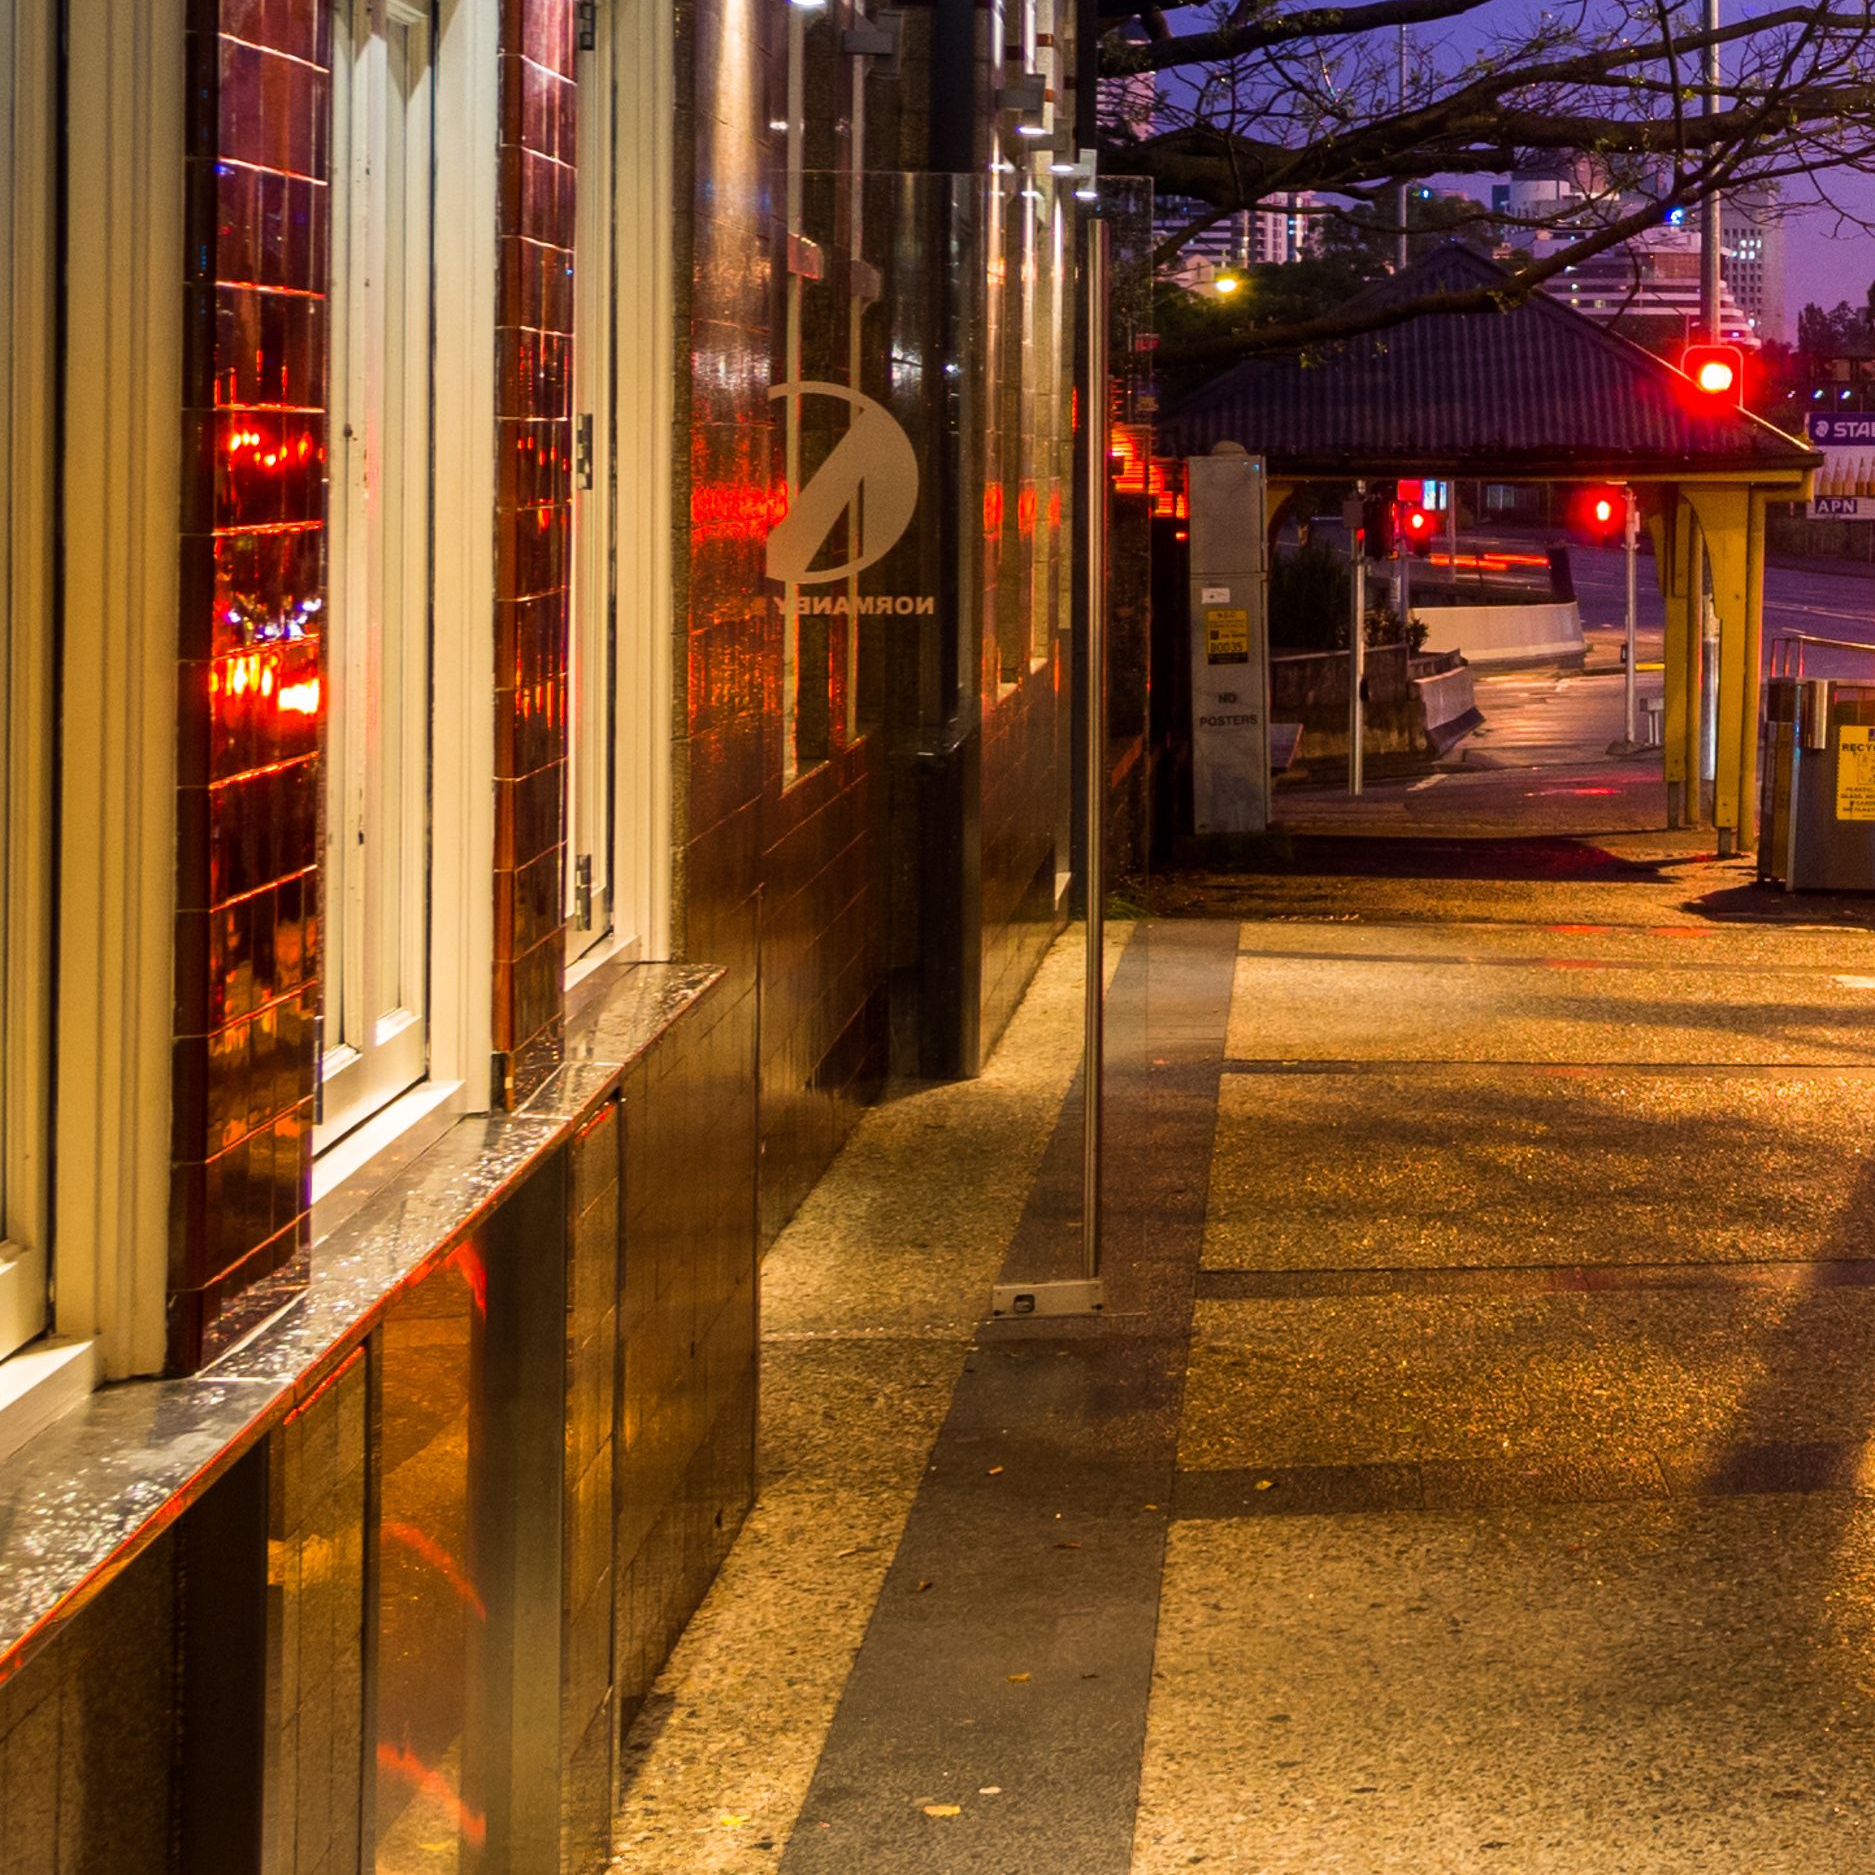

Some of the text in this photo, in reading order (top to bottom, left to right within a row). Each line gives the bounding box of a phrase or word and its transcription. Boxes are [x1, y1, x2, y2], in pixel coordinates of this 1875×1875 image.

[1817, 500, 1856, 514] APN
[1219, 693, 1237, 704] NO
[1200, 715, 1258, 727] POSTERS
